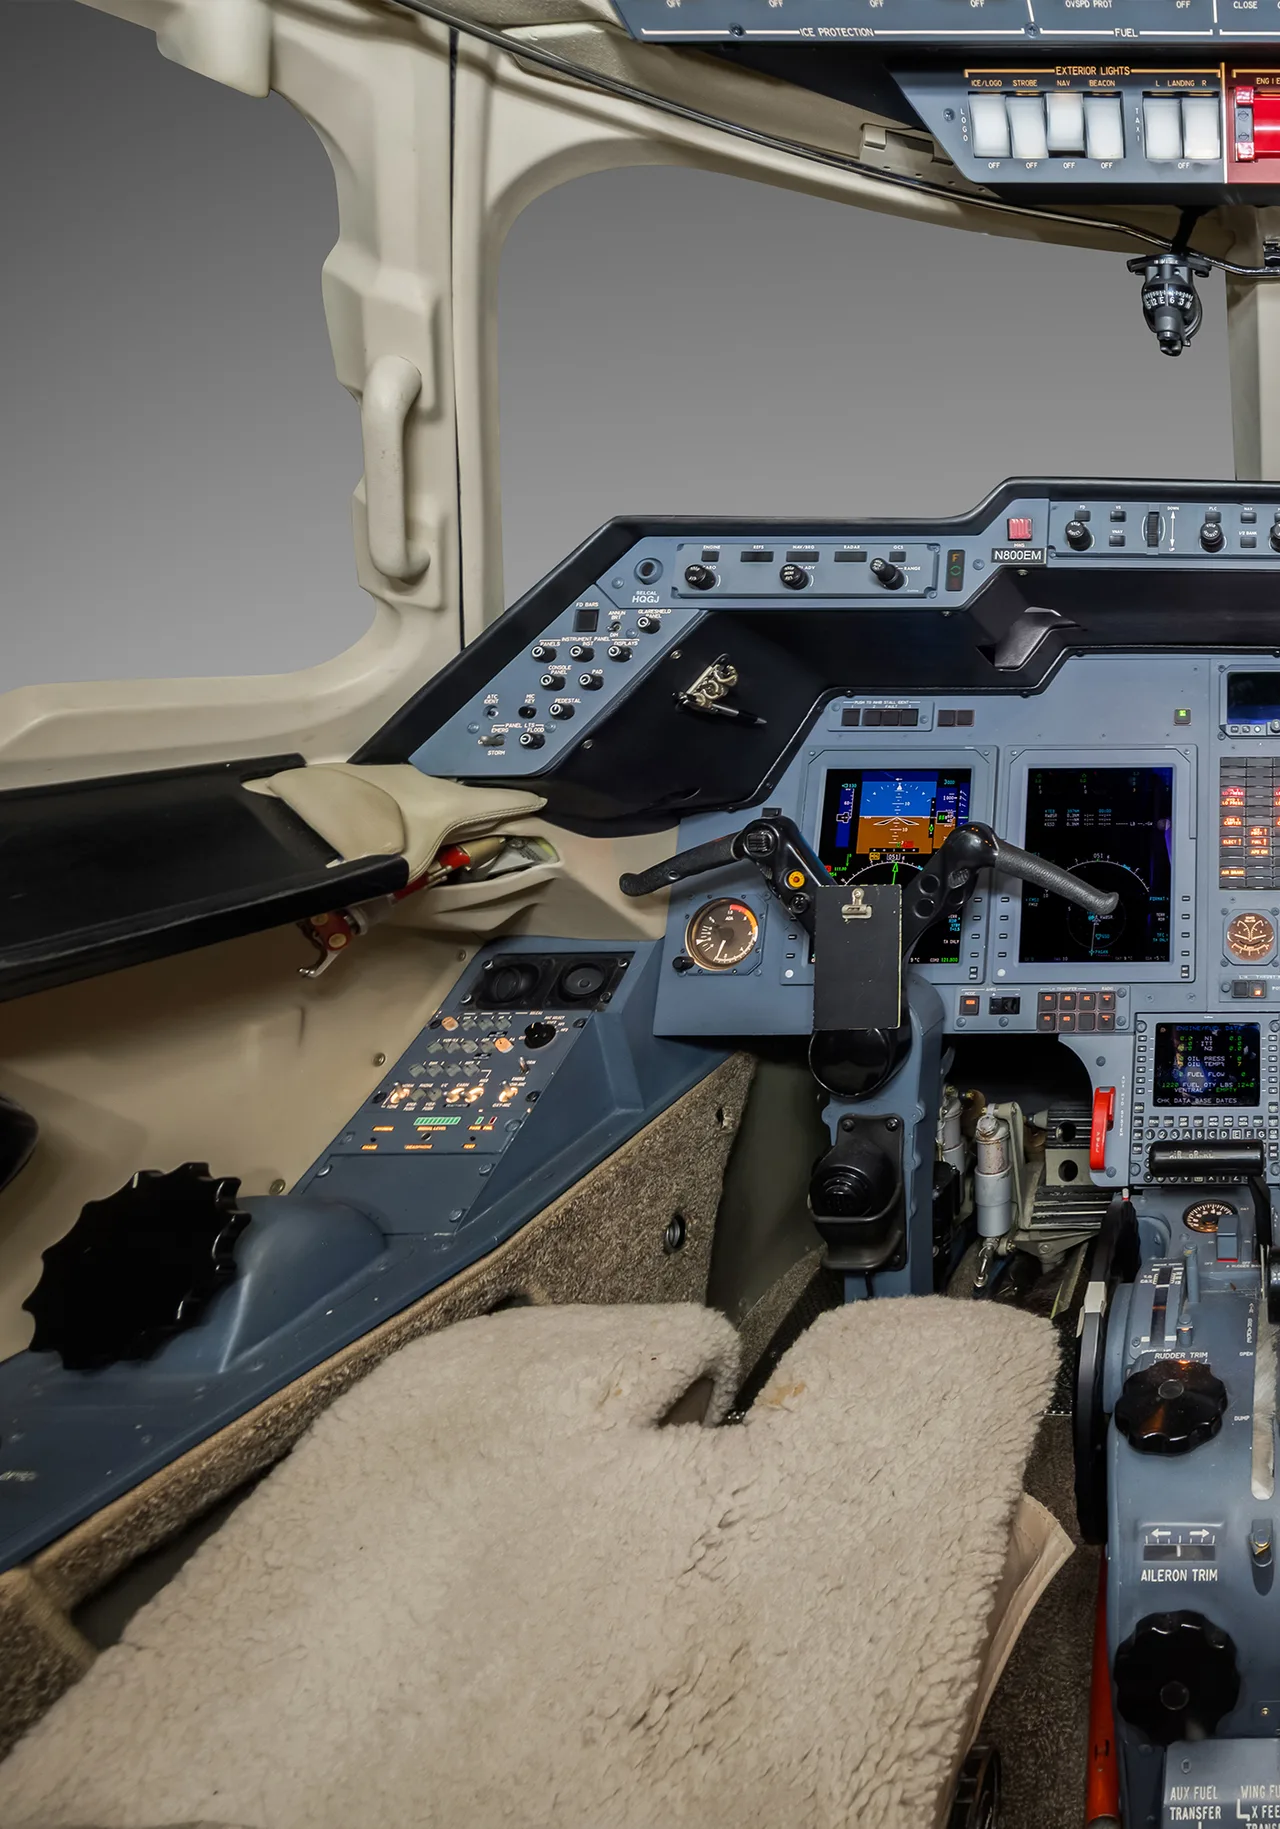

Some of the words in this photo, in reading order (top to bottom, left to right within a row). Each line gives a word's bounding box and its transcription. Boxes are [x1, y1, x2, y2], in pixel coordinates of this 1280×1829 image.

[666, 0, 681, 8] OFF
[769, 0, 783, 8] OFF
[869, 0, 884, 8] OFF
[970, 0, 985, 8] OFF
[1065, 0, 1091, 9] OVSPD
[1176, 0, 1191, 9] OFF
[1233, 1, 1258, 10] CLOSE
[800, 27, 815, 37] ICE
[818, 27, 875, 37] PROTECTION
[1114, 28, 1138, 38] FUEL
[1055, 66, 1096, 76] EXTERIOR
[1100, 66, 1130, 76] LIGHTS
[971, 79, 1002, 87] ICE/LOGO
[1012, 79, 1038, 87] STROBE
[1056, 79, 1071, 87] NAV
[1089, 79, 1115, 87] BEACON
[1167, 79, 1195, 87] LANDING
[1256, 77, 1270, 85] ENG
[994, 550, 1042, 561] N800EM
[632, 596, 660, 604] HQGJ
[1141, 1569, 1187, 1582] AILERON
[1191, 1569, 1218, 1582] TRIM
[1170, 1787, 1190, 1800] AUX
[1194, 1786, 1218, 1800] FUEL
[1240, 1785, 1265, 1799] WING
[1170, 1806, 1222, 1820] TRANSFER
[1251, 1805, 1258, 1818] X
